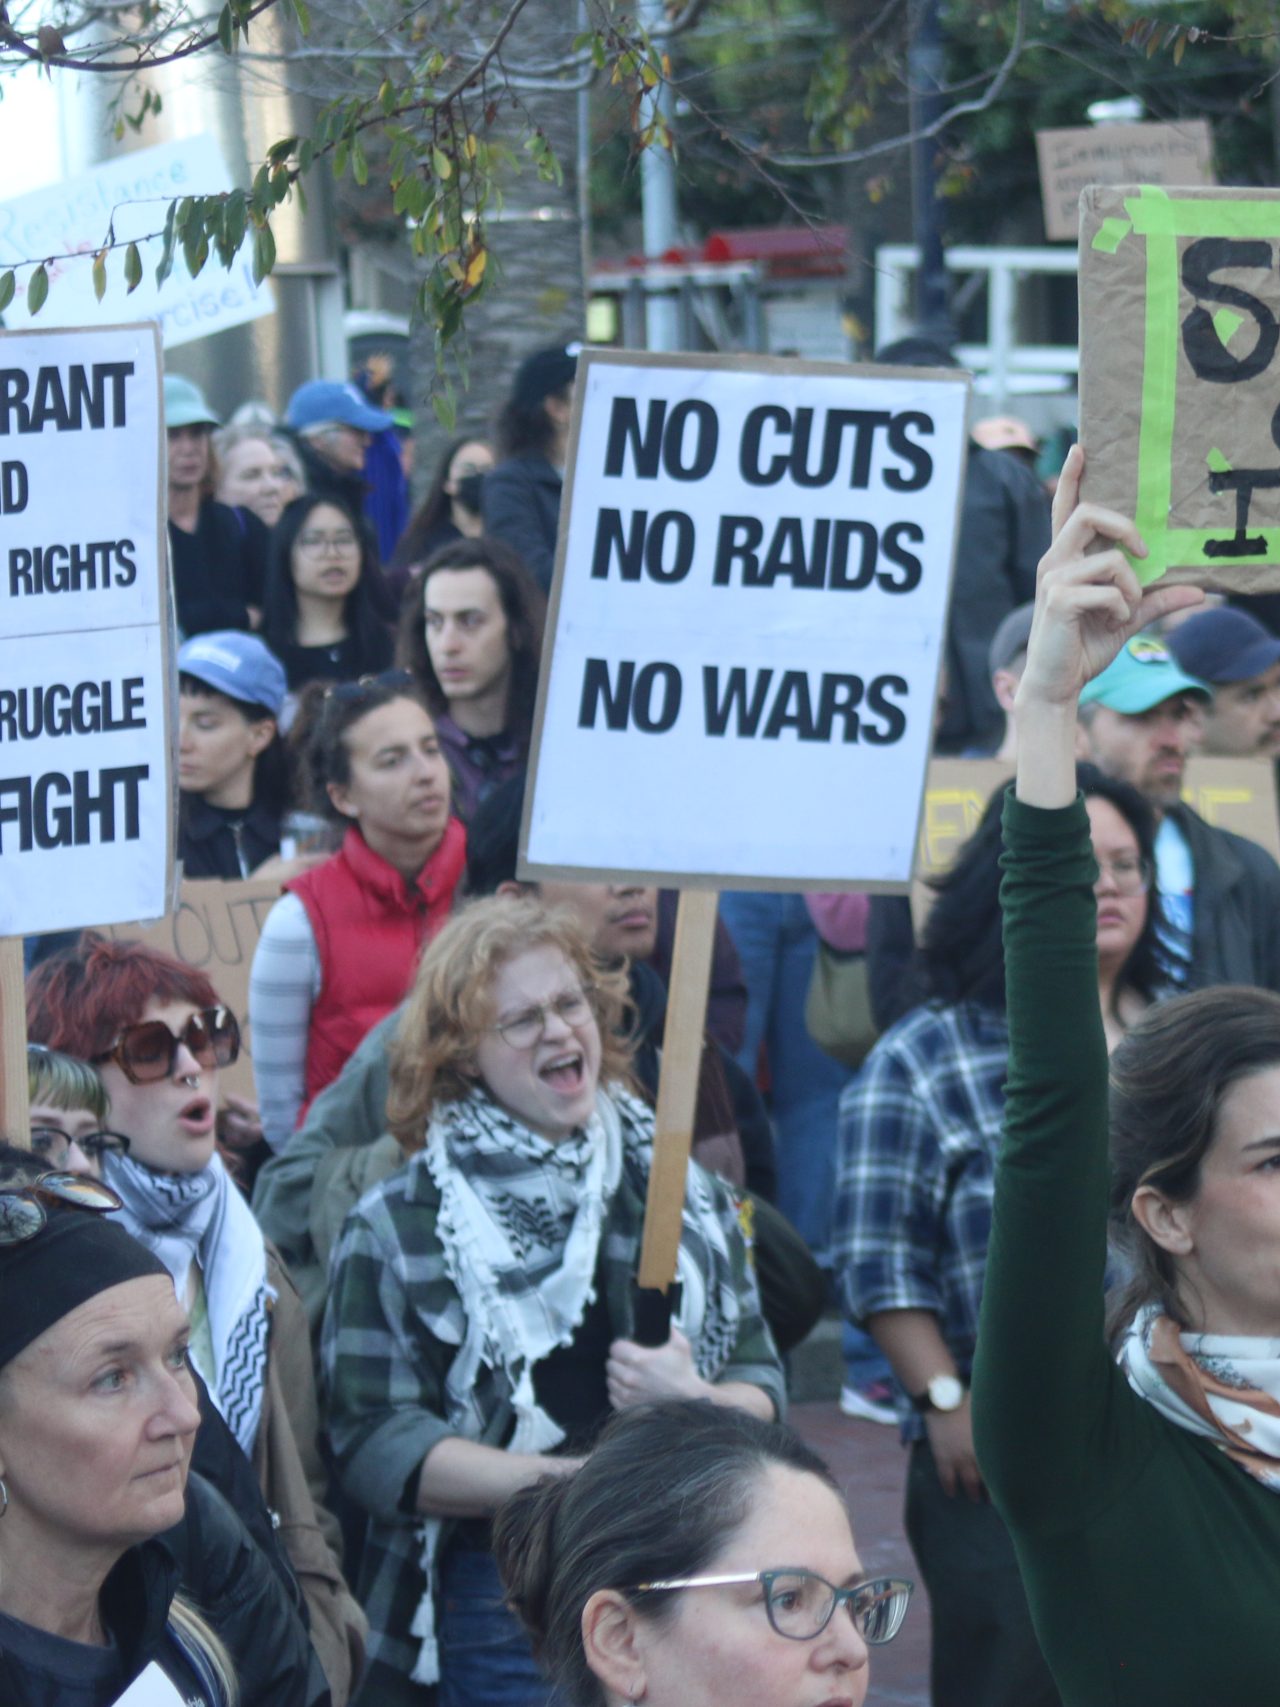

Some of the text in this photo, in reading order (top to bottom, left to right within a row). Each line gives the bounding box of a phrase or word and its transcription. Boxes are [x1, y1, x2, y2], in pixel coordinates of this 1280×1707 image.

[0, 361, 135, 435] RANT
[603, 396, 935, 492] NO CUTS
[8, 538, 137, 597] RIGHTS
[590, 507, 925, 594] NO RAIDS
[577, 657, 909, 746] NO WARS
